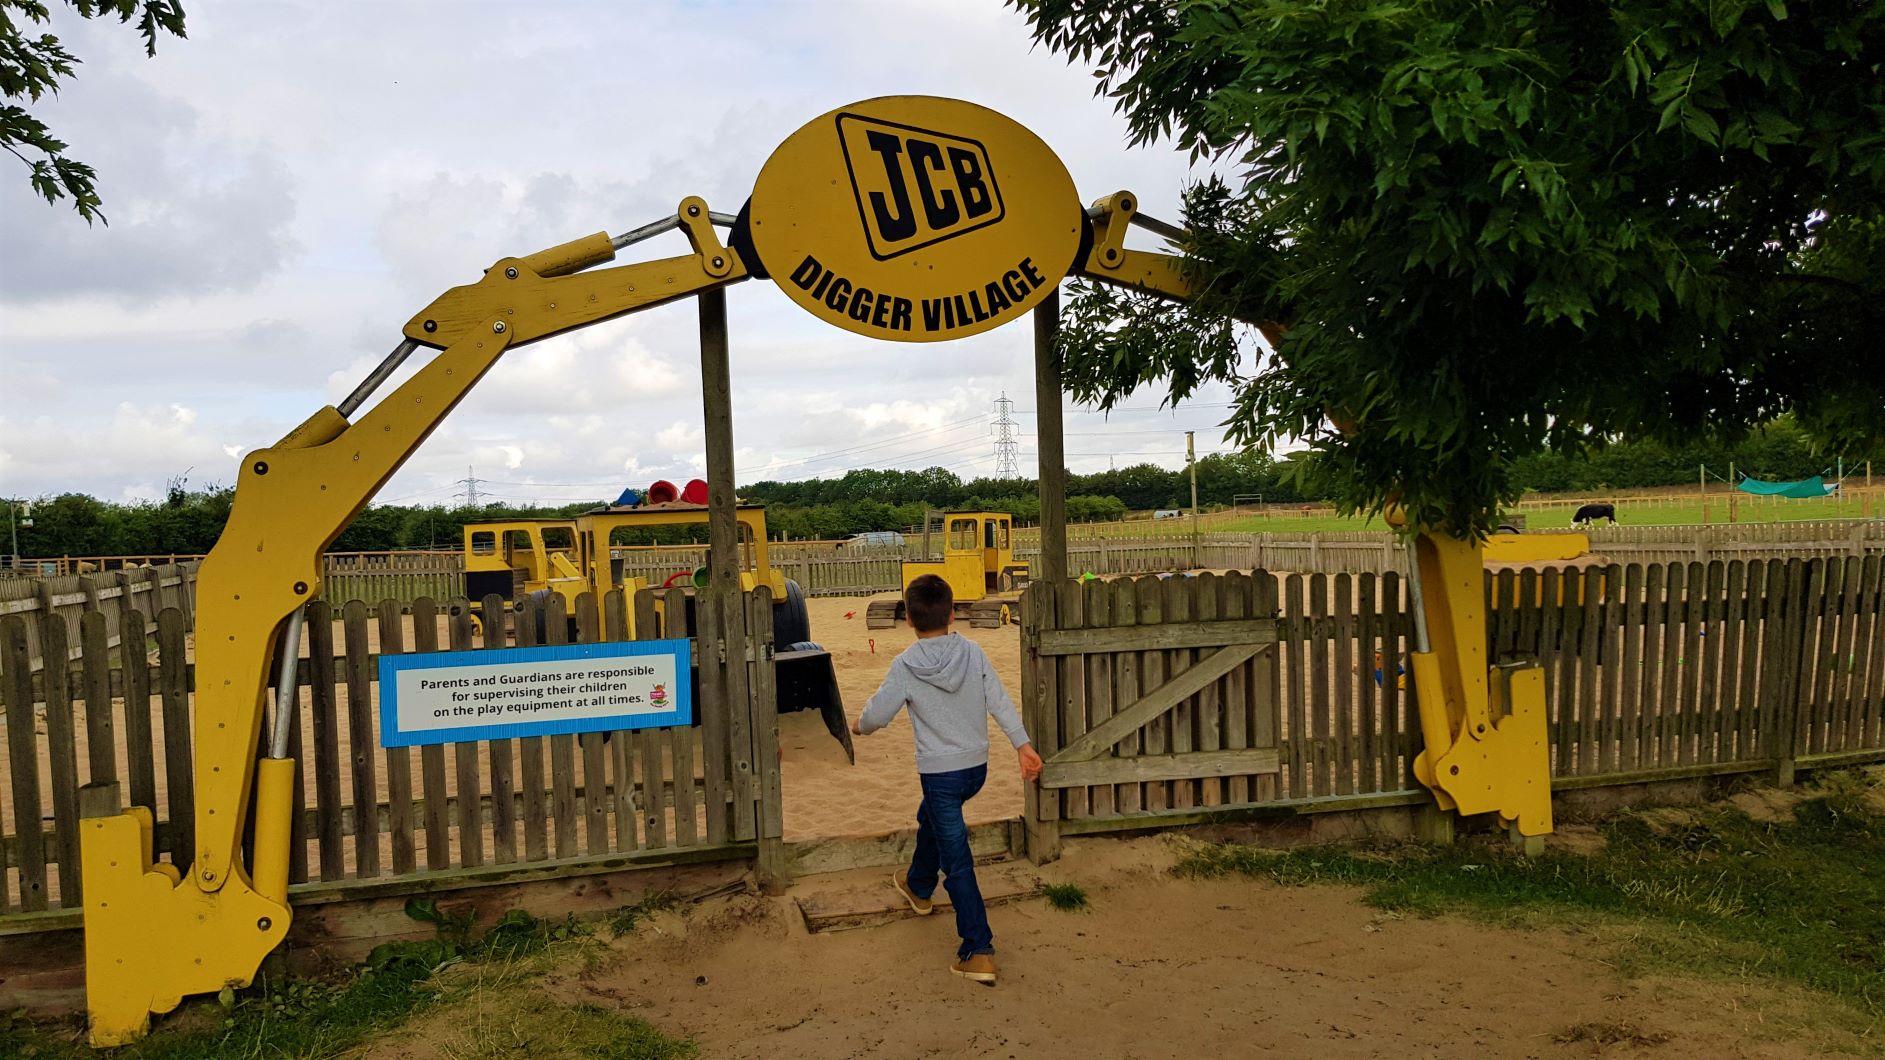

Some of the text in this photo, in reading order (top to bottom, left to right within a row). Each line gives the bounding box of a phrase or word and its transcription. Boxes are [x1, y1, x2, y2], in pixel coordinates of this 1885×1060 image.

[866, 129, 993, 243] JCB
[789, 254, 1046, 332] DIGGER VILLAGE
[421, 665, 655, 690] Parents and Guardians are responsible
[452, 681, 627, 702] for supervising their children
[433, 709, 449, 718] on
[453, 706, 474, 716] the
[478, 703, 504, 717] play
[507, 698, 573, 713] equipment
[576, 697, 589, 707] at
[591, 695, 606, 706] all
[609, 694, 645, 705] times.
